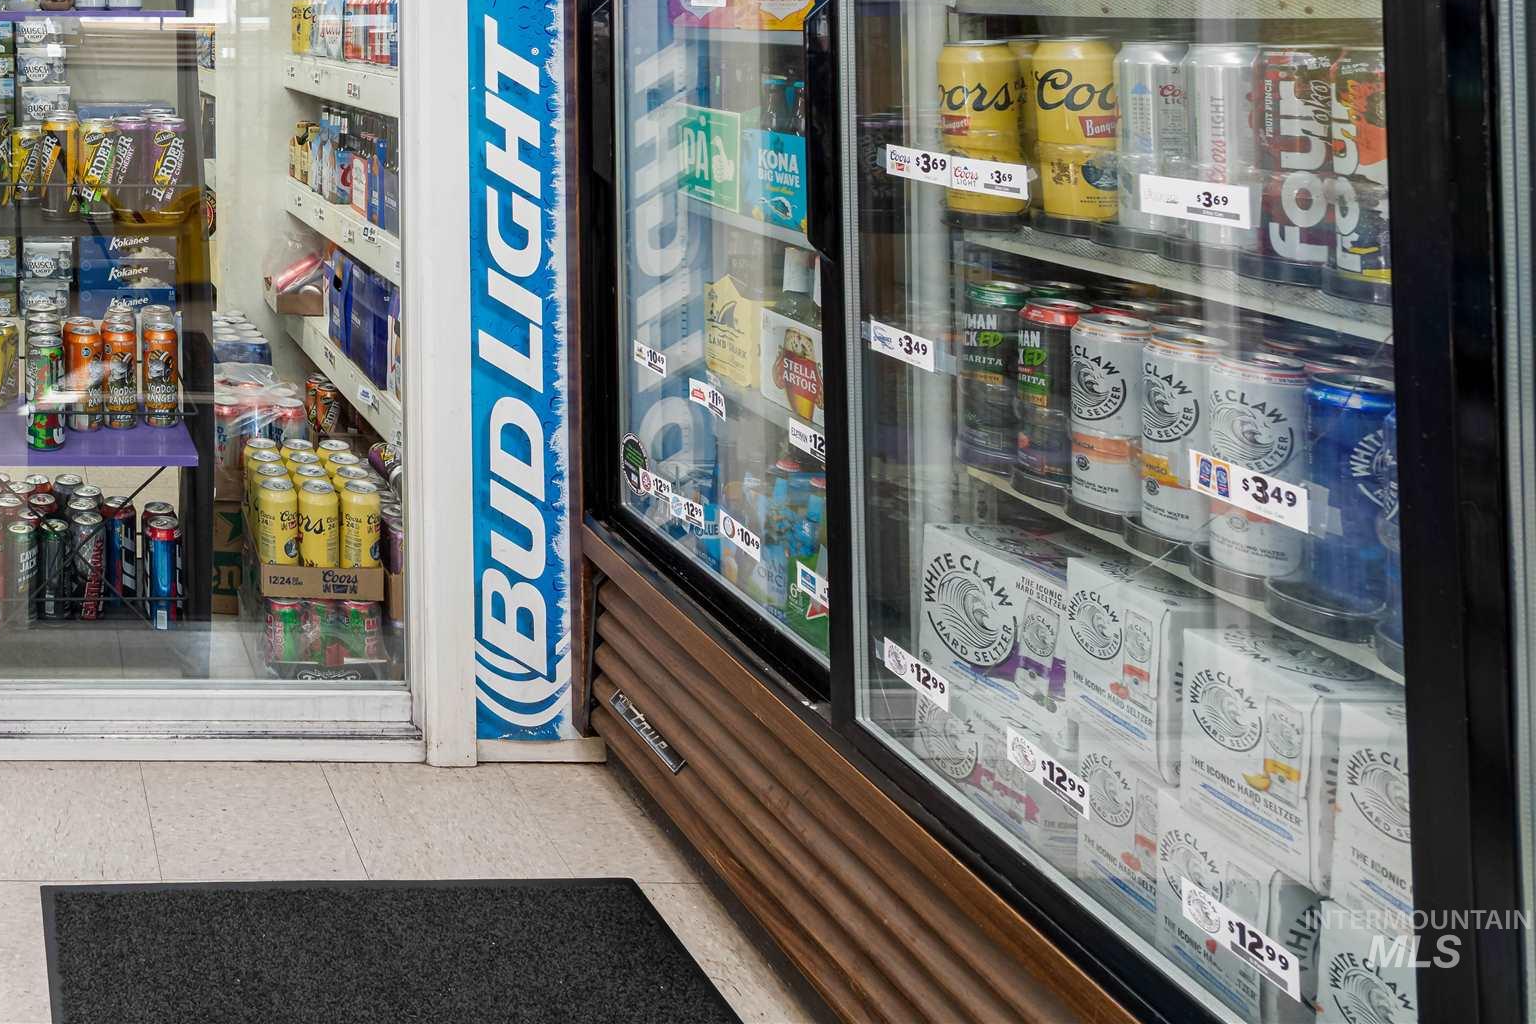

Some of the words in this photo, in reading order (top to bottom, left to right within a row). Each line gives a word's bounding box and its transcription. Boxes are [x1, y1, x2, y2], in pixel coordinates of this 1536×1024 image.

[21, 27, 48, 36] BUSCH
[24, 65, 49, 75] BUSCH
[1264, 79, 1273, 113] PUNCH
[1211, 94, 1225, 139] LIGHT
[758, 149, 799, 175] KONA
[889, 148, 911, 164] Coors
[775, 172, 801, 189] WAVE
[953, 166, 978, 182] Coors
[956, 179, 977, 188] LIGHT
[478, 15, 544, 396] LIGHT
[109, 235, 150, 251] Kokanee
[107, 266, 149, 282] Kokanee
[782, 357, 817, 382] STELLA
[1073, 344, 1120, 376] CLAW
[782, 372, 818, 394] ARTOIS
[1144, 362, 1193, 396] CLAW
[1086, 385, 1121, 417] SELTZER
[1226, 389, 1287, 424] CLAW
[1156, 406, 1194, 439] SELTZER
[1247, 435, 1290, 474] SELTZER
[482, 396, 547, 676] BUD
[322, 569, 358, 584] Coors
[924, 552, 957, 603] WHITE
[959, 554, 1013, 607] CLAW
[1020, 575, 1035, 588] THE
[1035, 581, 1063, 602] ICONIC
[1015, 581, 1034, 597] HARD
[1036, 591, 1069, 613] SELTZER
[1067, 589, 1089, 622] WHITE
[1089, 591, 1120, 624] CLAW
[936, 620, 969, 657] HARD
[973, 624, 1013, 663] SELTZER
[1190, 668, 1214, 706] WHITE
[1215, 671, 1258, 711] CLAW
[1125, 704, 1153, 728] SELTZER
[1200, 716, 1226, 743] HARD
[1229, 721, 1259, 749] SELTZER
[1346, 747, 1376, 787] WHITE
[1191, 755, 1206, 771] THE
[1205, 764, 1236, 790] ICONIC
[1236, 779, 1262, 805] HARD
[1263, 794, 1301, 827] SELTZER
[1161, 829, 1183, 864] WHITE
[1183, 833, 1220, 875] CLAW
[1370, 855, 1407, 890] ICONIC
[1329, 951, 1359, 990] WHITE
[1362, 957, 1416, 1012] CLAW
